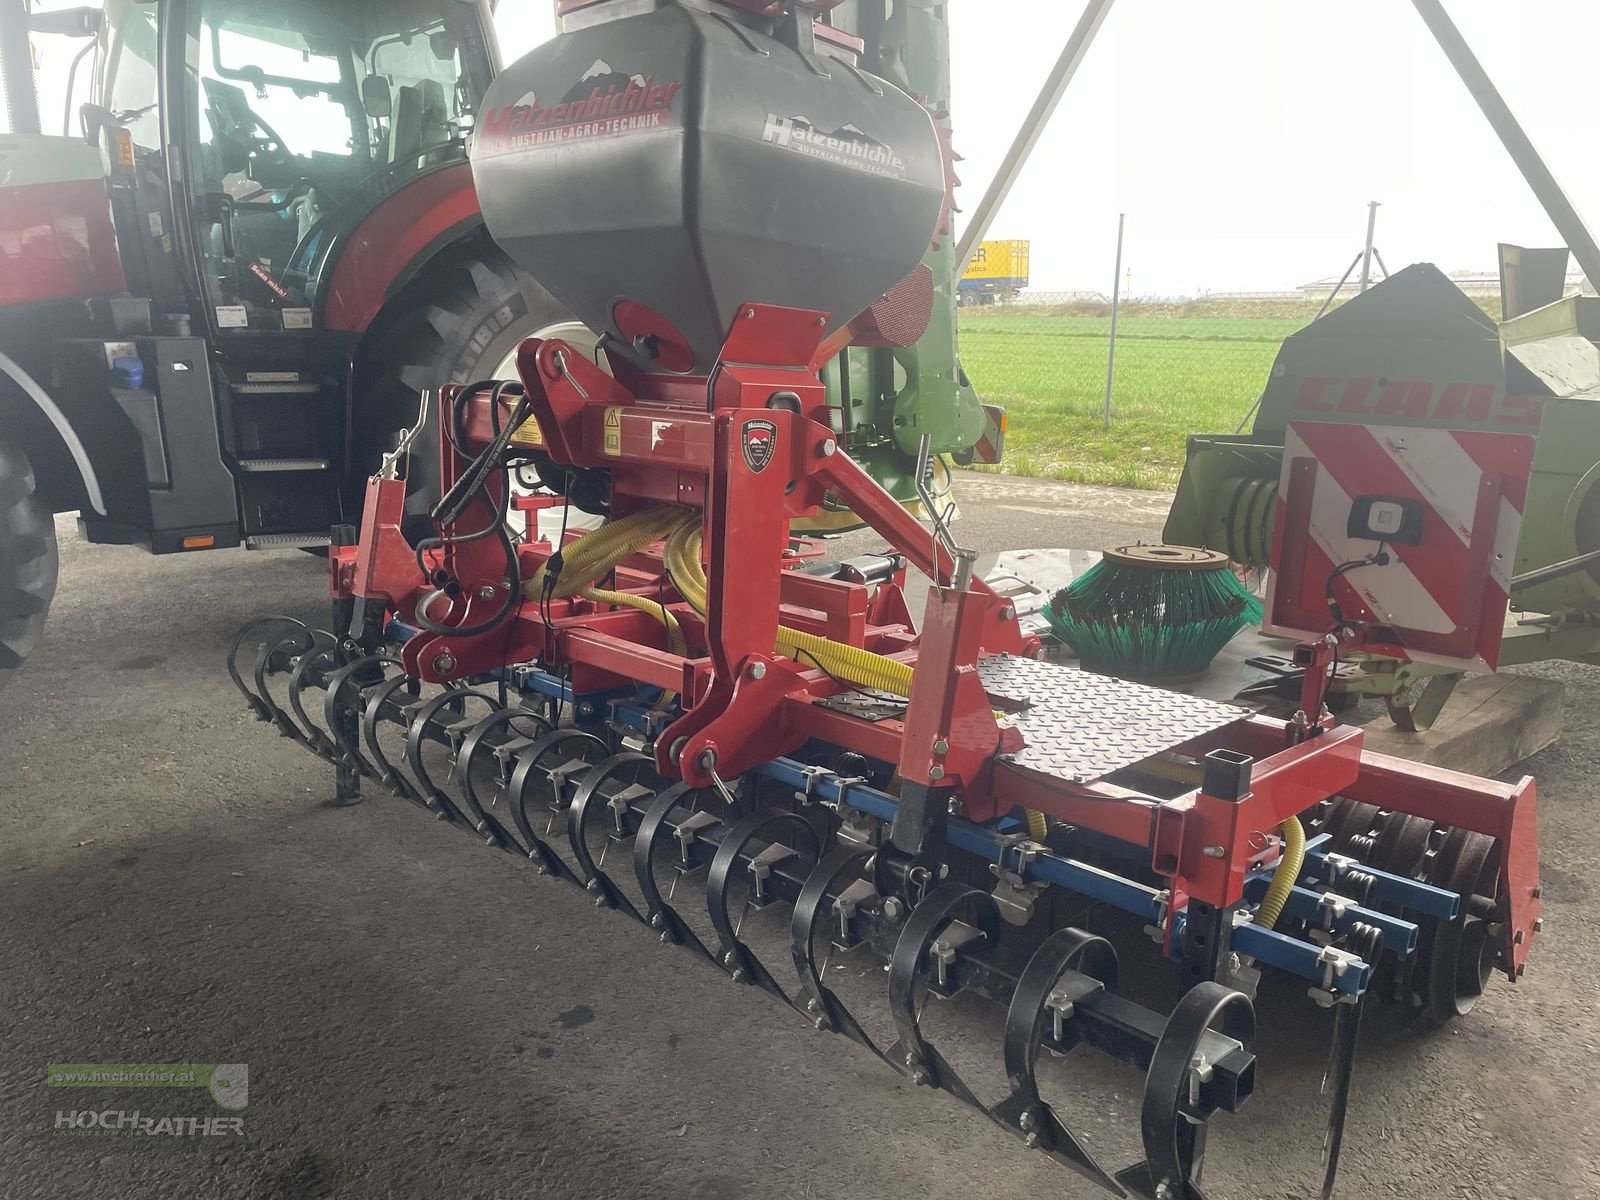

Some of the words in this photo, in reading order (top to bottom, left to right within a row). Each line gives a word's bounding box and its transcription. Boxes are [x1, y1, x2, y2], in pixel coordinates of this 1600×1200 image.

[480, 73, 683, 147] Hatzenbichler
[511, 112, 661, 148] AUSTRIAN-AGRO-TECHNIK
[251, 264, 268, 281] Scan
[267, 279, 288, 297] mich!
[1292, 377, 1544, 425] CLAAS
